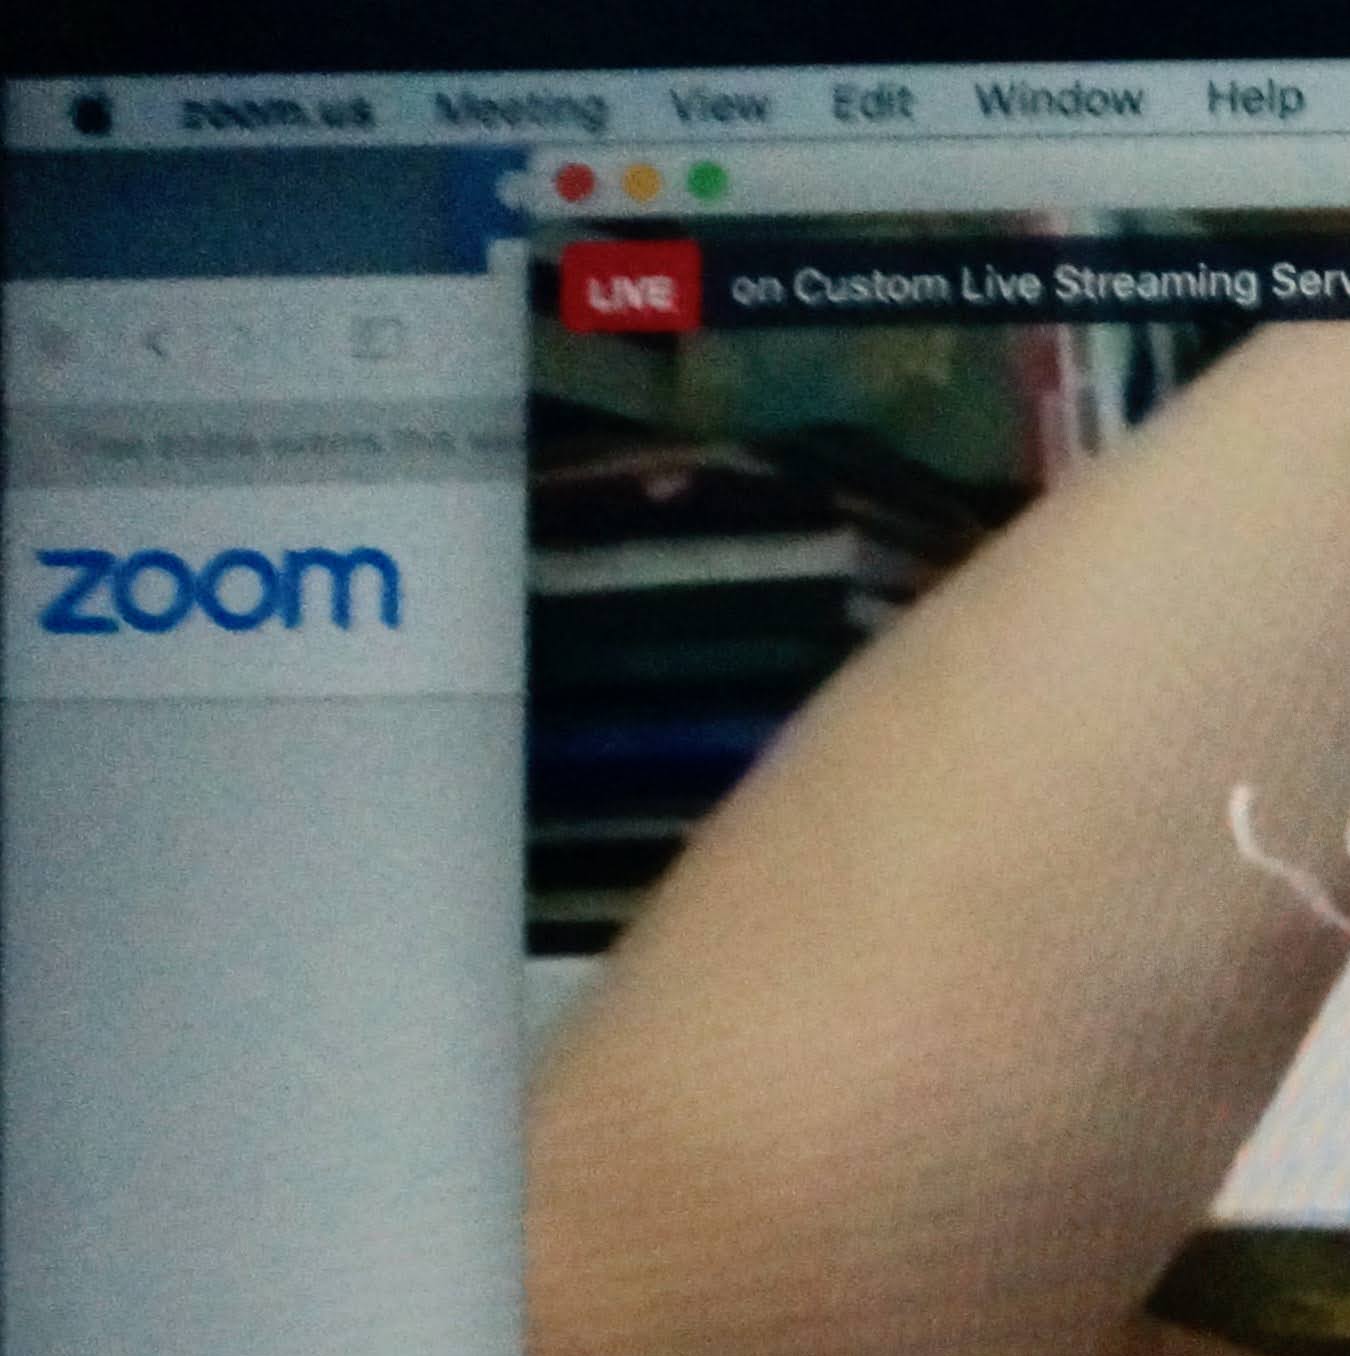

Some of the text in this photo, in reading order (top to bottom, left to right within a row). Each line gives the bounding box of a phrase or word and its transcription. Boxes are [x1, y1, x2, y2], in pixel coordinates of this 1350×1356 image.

[432, 91, 608, 135] Meeting
[671, 86, 769, 123] View
[833, 81, 915, 120] Edit
[976, 80, 1143, 118] Window
[1208, 76, 1305, 121] Help
[587, 273, 677, 315] LIVE
[732, 275, 784, 306] on
[793, 266, 950, 303] Custom
[961, 264, 1042, 301] Live
[1054, 261, 1259, 305] Streaming
[35, 547, 402, 634] zoom
